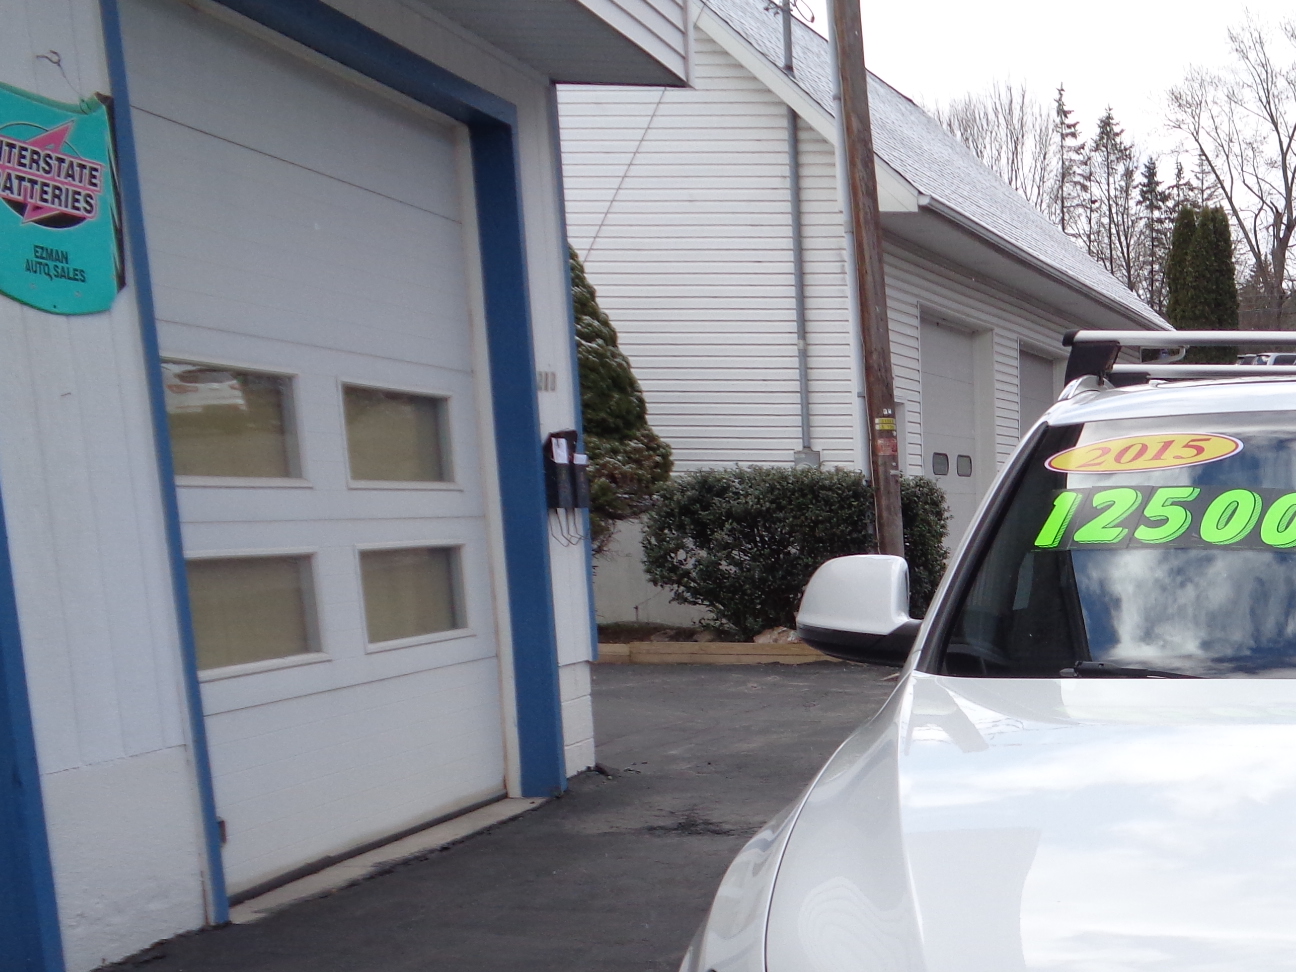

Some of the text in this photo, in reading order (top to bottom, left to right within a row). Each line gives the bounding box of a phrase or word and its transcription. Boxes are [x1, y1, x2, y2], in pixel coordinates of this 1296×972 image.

[0, 171, 95, 215] ATTERIES
[33, 244, 69, 265] EZMAN
[25, 259, 86, 283] AUTO SALES
[1075, 437, 1213, 469] 2015
